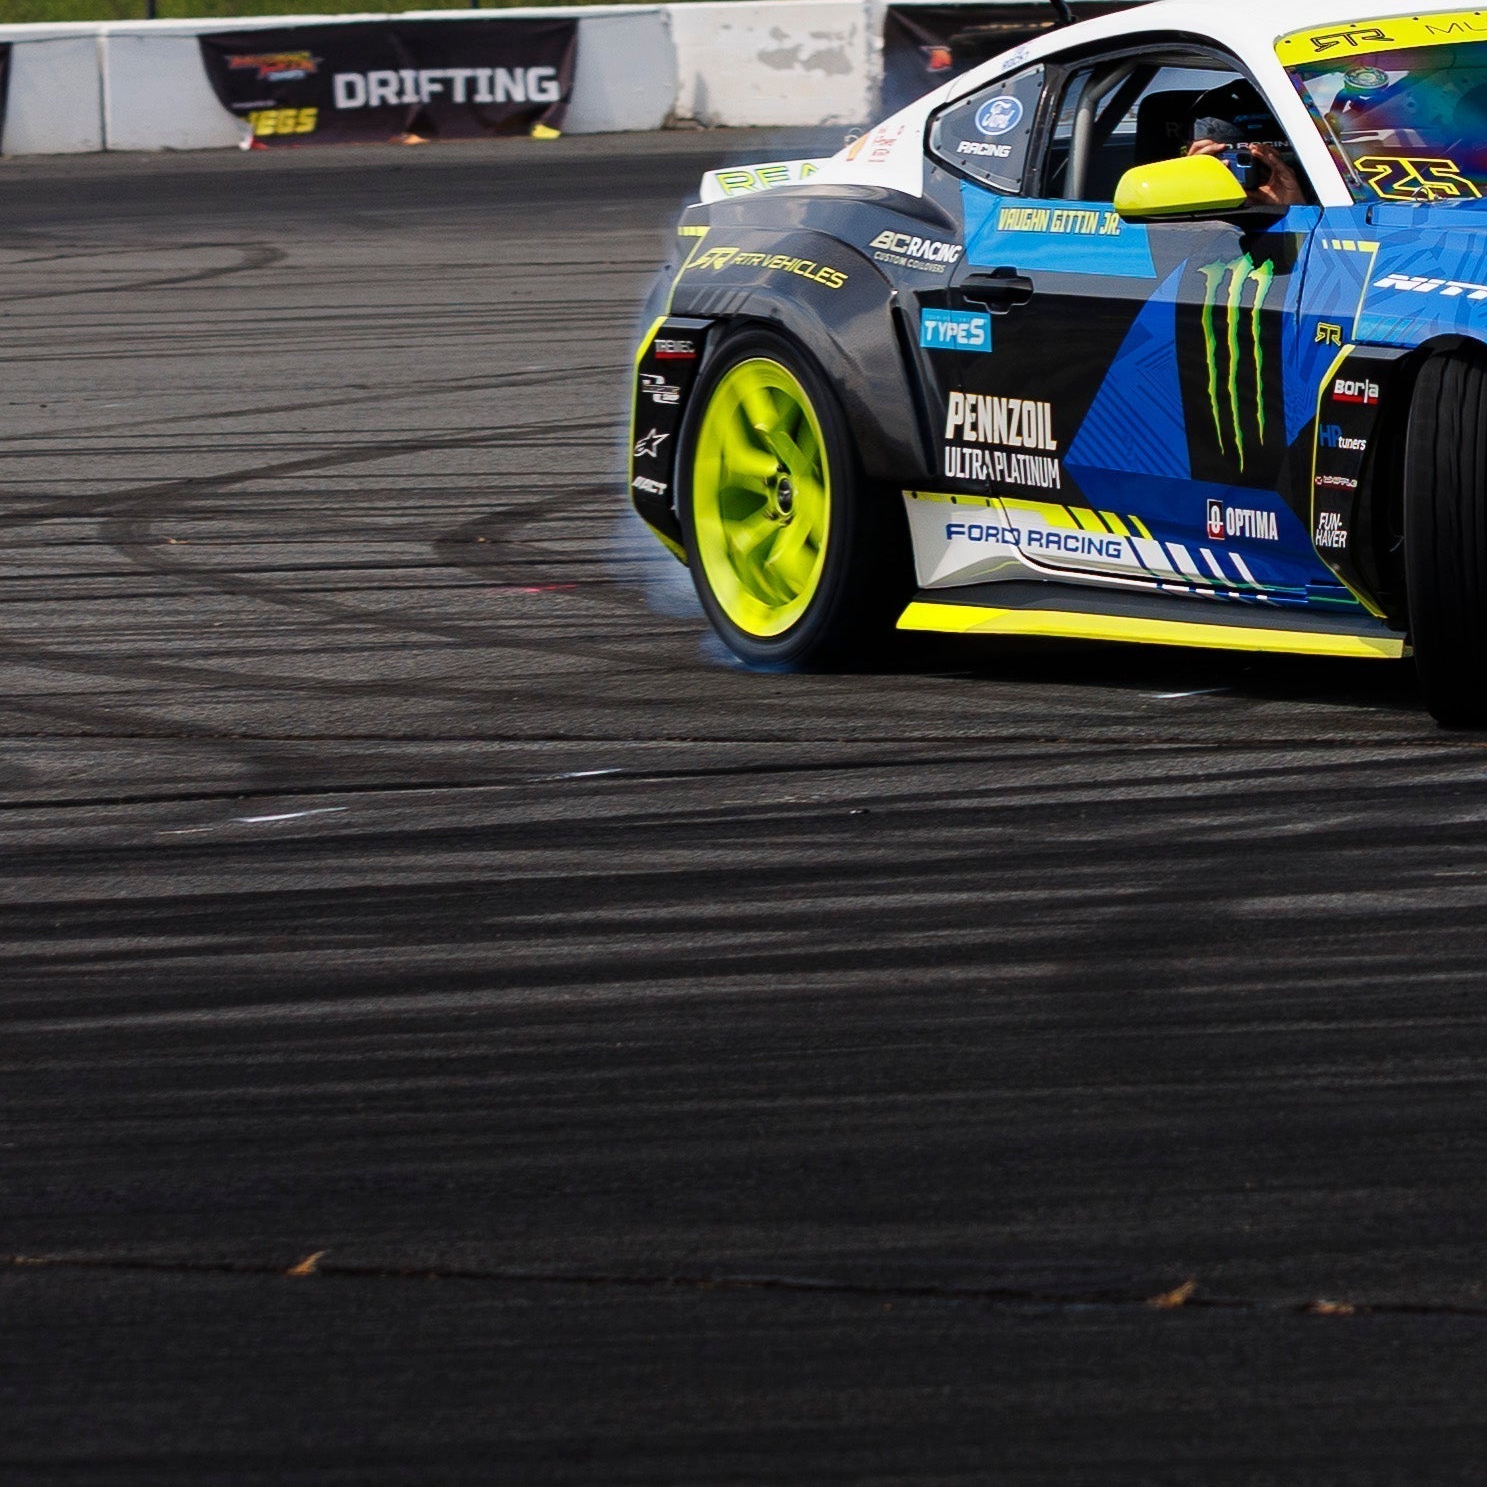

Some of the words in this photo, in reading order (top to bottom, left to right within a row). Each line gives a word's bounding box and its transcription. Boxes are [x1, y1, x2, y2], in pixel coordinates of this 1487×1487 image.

[334, 67, 561, 109] DRIFTING
[957, 141, 1012, 158] RACING
[998, 208, 1050, 232] VAUGHN
[1050, 210, 1098, 234] GITTIN
[760, 252, 848, 289] VEHICLES
[945, 391, 1057, 451] PENNZOIL
[944, 445, 991, 481] ULTRA
[994, 451, 1061, 490] PLATINUM
[946, 523, 1020, 545] FORD
[1027, 530, 1122, 559] RACING
[1226, 507, 1278, 541] OPTIMA
[1315, 529, 1347, 548] HAVER
